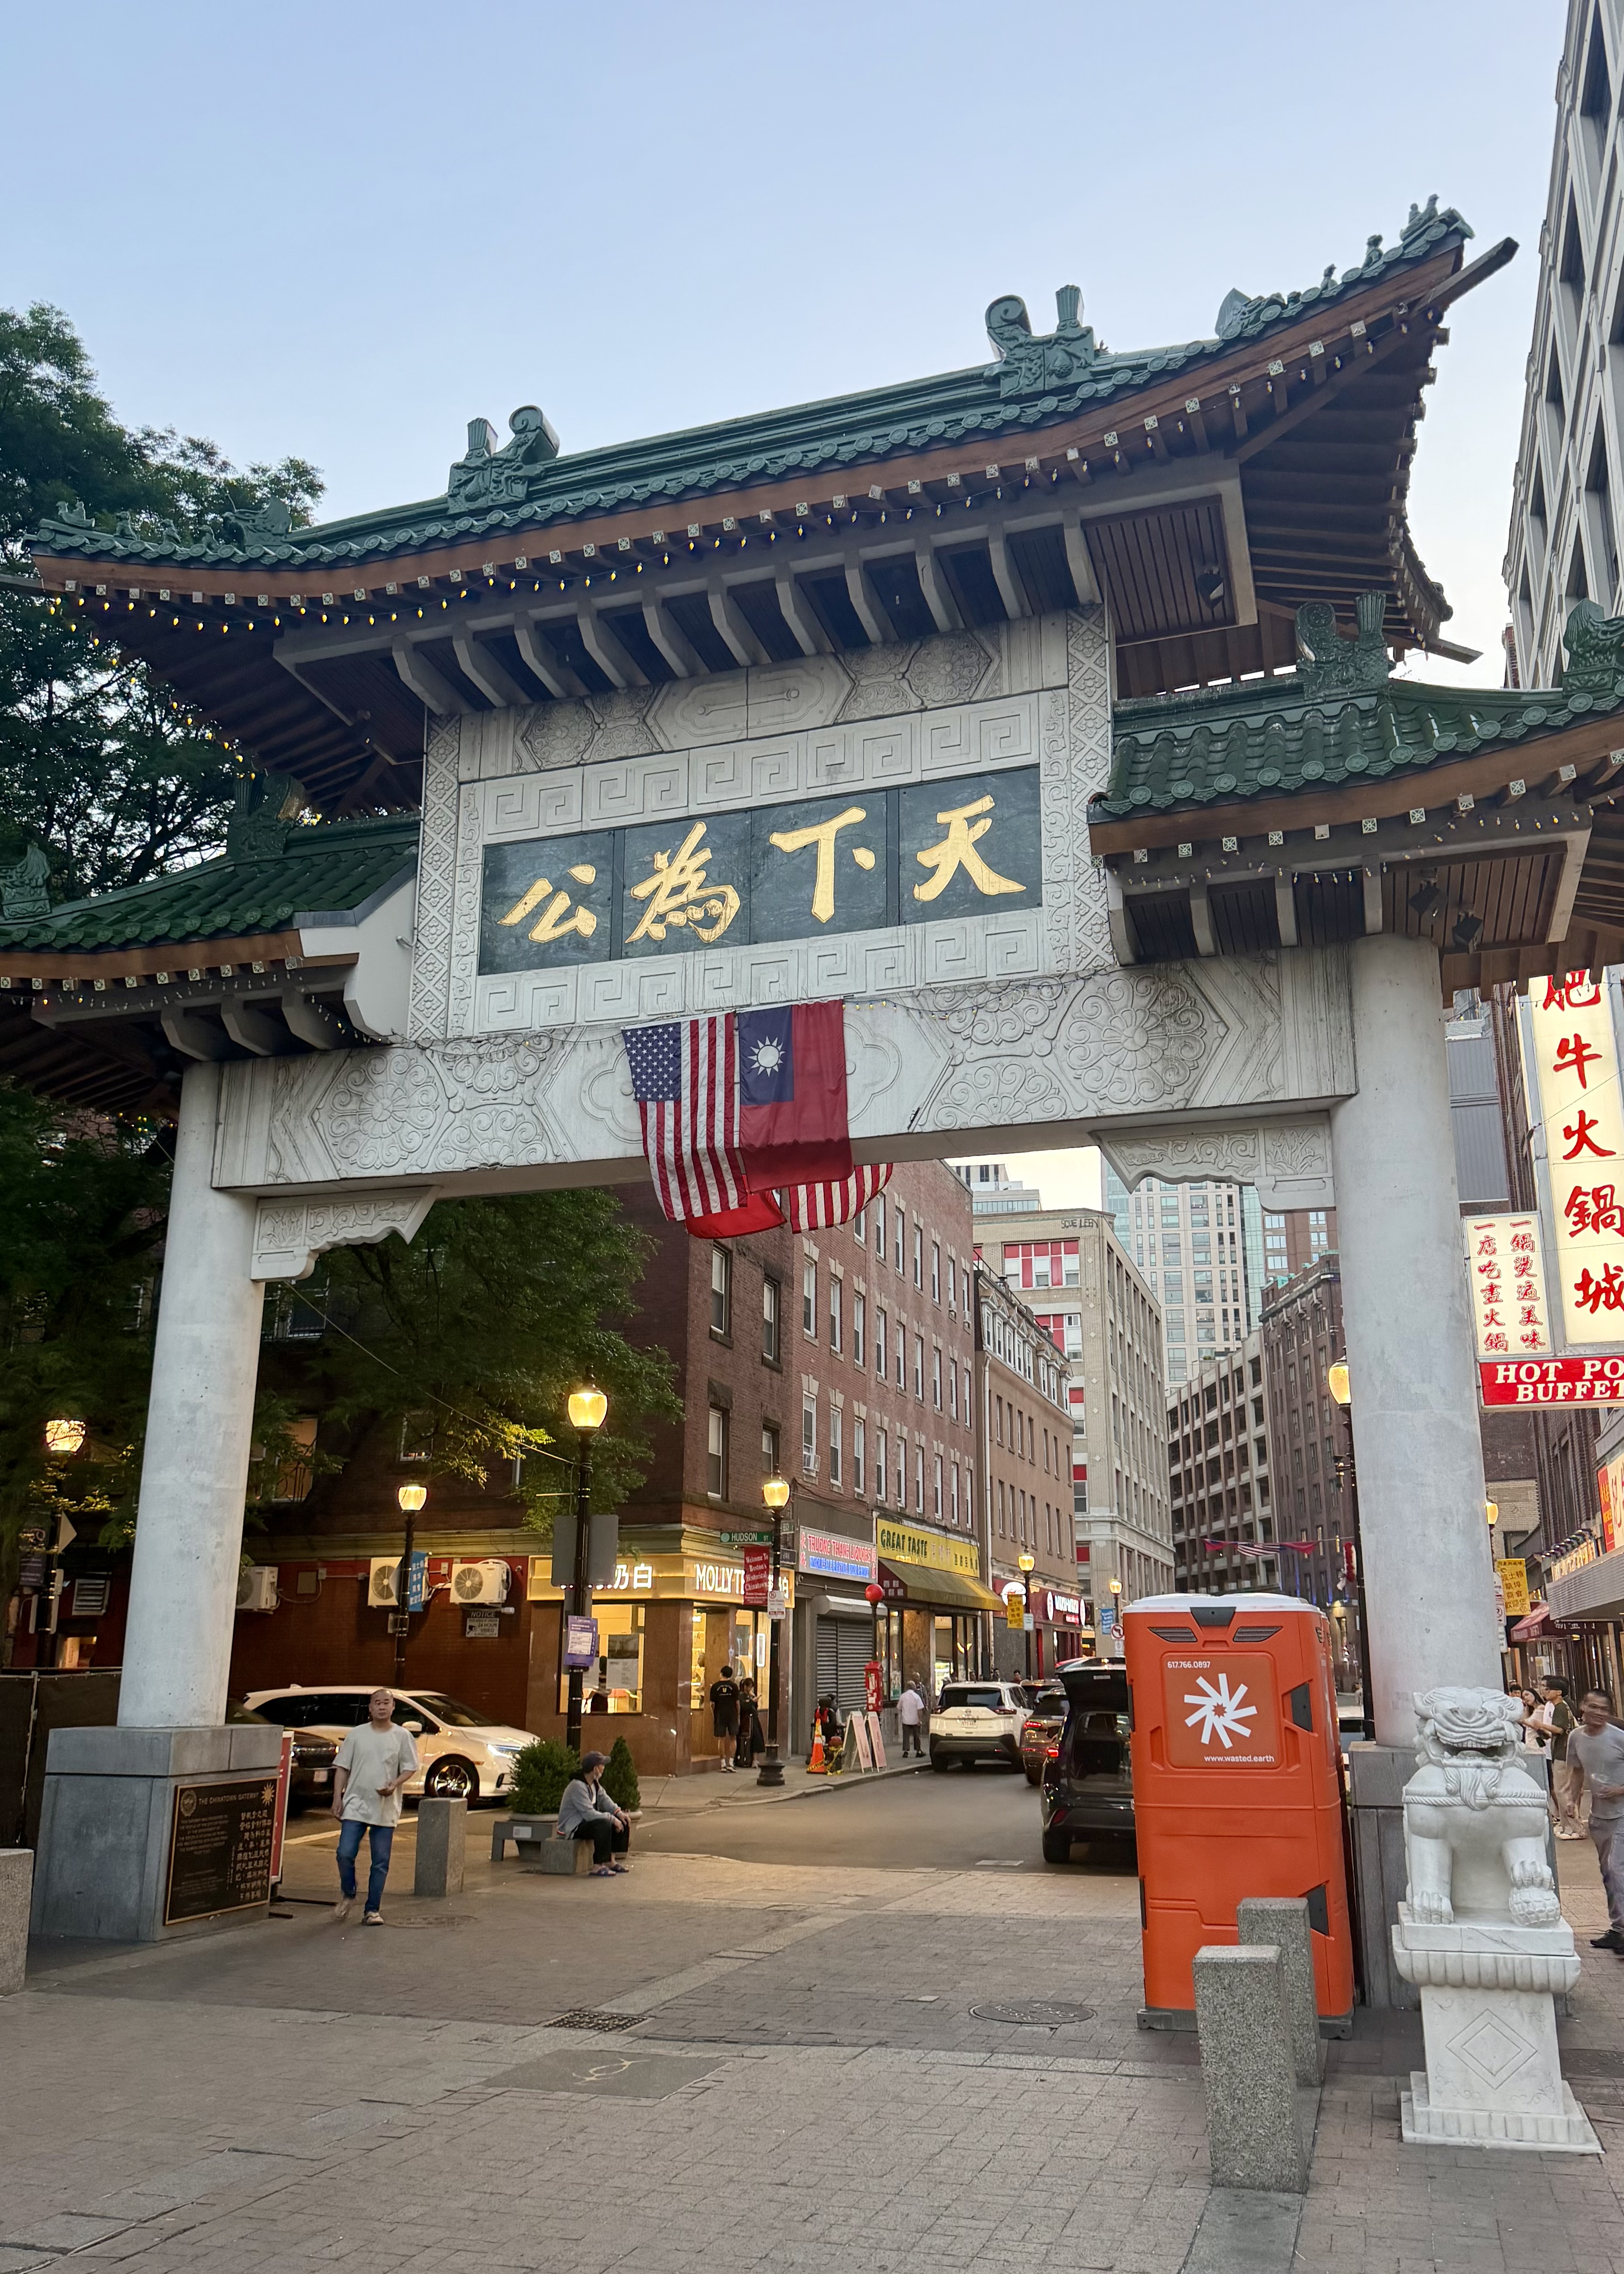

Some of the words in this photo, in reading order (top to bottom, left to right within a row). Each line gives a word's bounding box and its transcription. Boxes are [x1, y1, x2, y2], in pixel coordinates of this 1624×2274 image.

[1495, 1362, 1562, 1384] HOT
[1582, 1358, 1624, 1379] PO
[1516, 1379, 1624, 1402] BUFFET
[732, 1533, 757, 1542] HUDSON
[881, 1529, 905, 1552] GREAT
[908, 1536, 928, 1557] TASTE
[807, 1534, 830, 1555] TRUONG
[831, 1540, 850, 1559] THANH
[850, 1544, 871, 1564] LIQUORS
[746, 1555, 763, 1564] Welcome
[746, 1571, 767, 1582] Historical
[745, 1581, 768, 1592] Chinatown
[1204, 1754, 1274, 1763] www.wasted.earth
[209, 1795, 237, 1804] CHINATOWN
